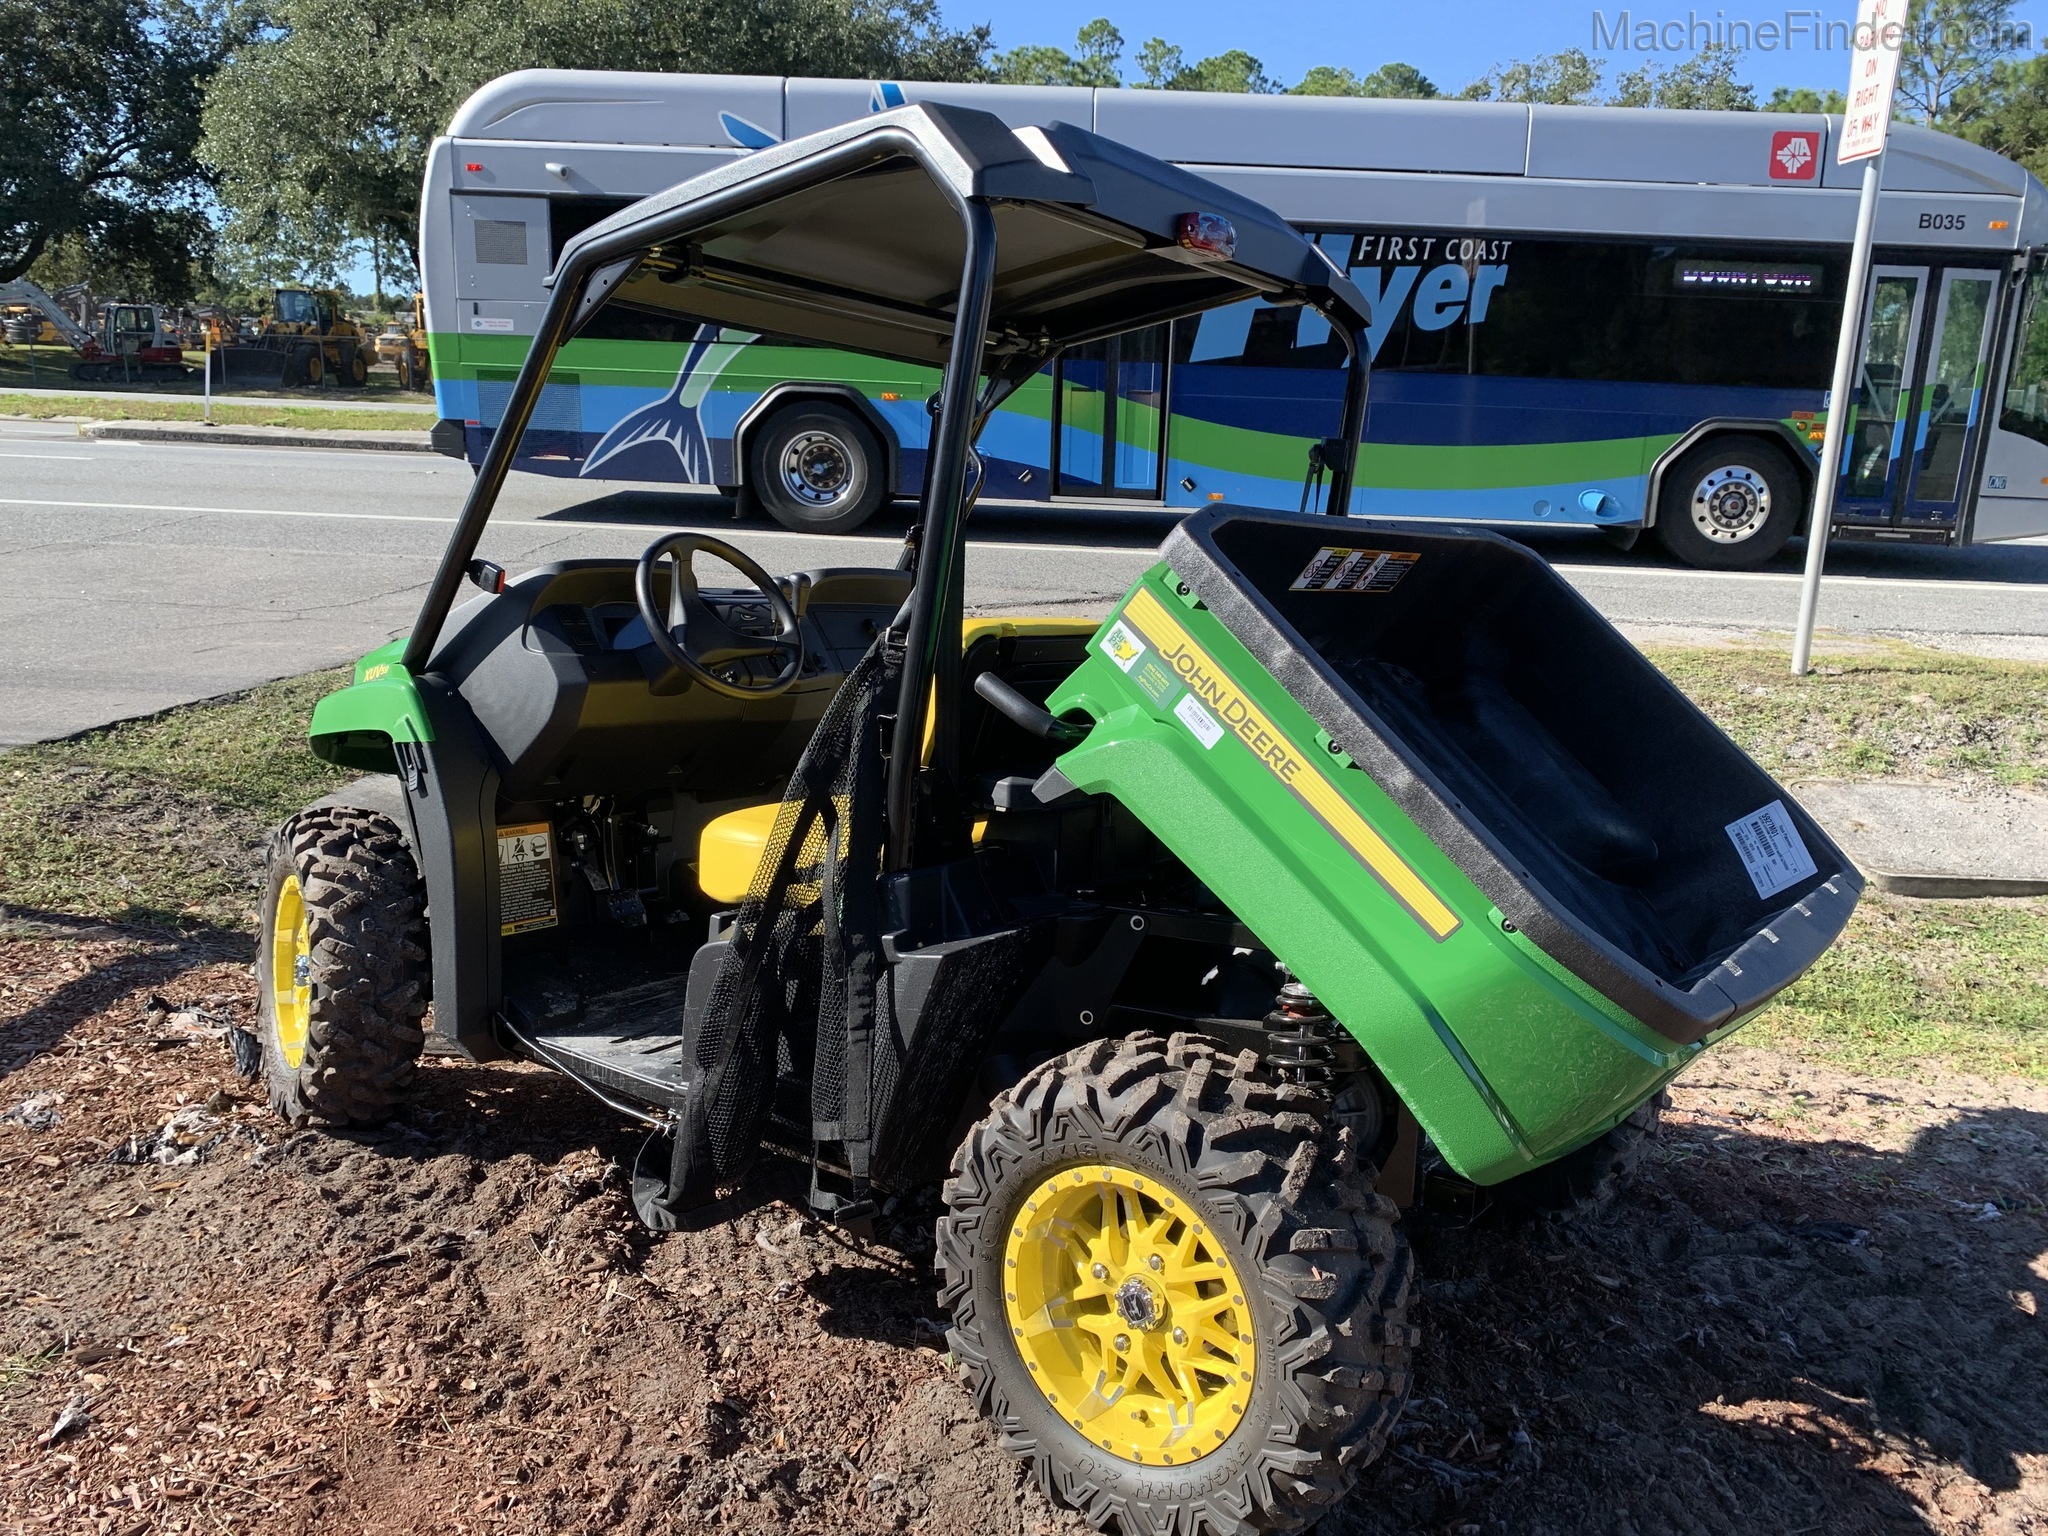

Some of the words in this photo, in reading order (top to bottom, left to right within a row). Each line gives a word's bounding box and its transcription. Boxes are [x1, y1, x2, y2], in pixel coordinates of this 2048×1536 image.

[1876, 0, 1888, 18] NO
[1865, 57, 1879, 77] ON
[1854, 84, 1880, 109] RIGHT
[1846, 118, 1859, 138] OF
[1861, 112, 1880, 133] WAY
[1918, 212, 1966, 231] B035
[1358, 235, 1436, 261] FIRST
[1445, 237, 1512, 262] COAST
[1163, 643, 1226, 705] JOHN
[1223, 697, 1301, 781] DEERE
[504, 828, 528, 837] WARNING
